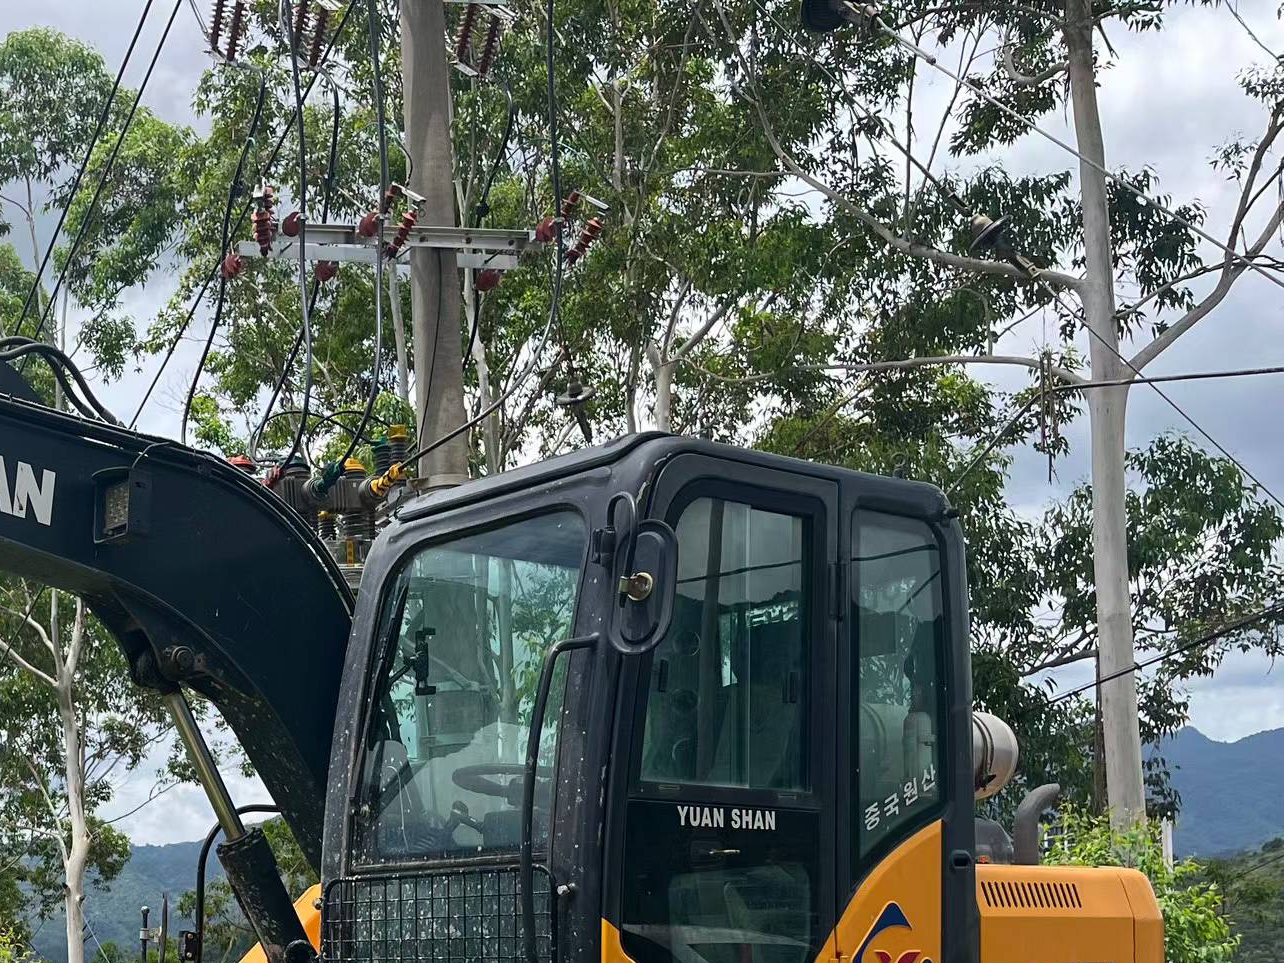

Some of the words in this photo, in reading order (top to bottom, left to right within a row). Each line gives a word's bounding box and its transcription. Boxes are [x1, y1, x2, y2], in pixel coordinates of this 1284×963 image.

[677, 805, 724, 828] YUAN
[731, 808, 776, 831] SHAN
[864, 763, 936, 831] 중국원산
